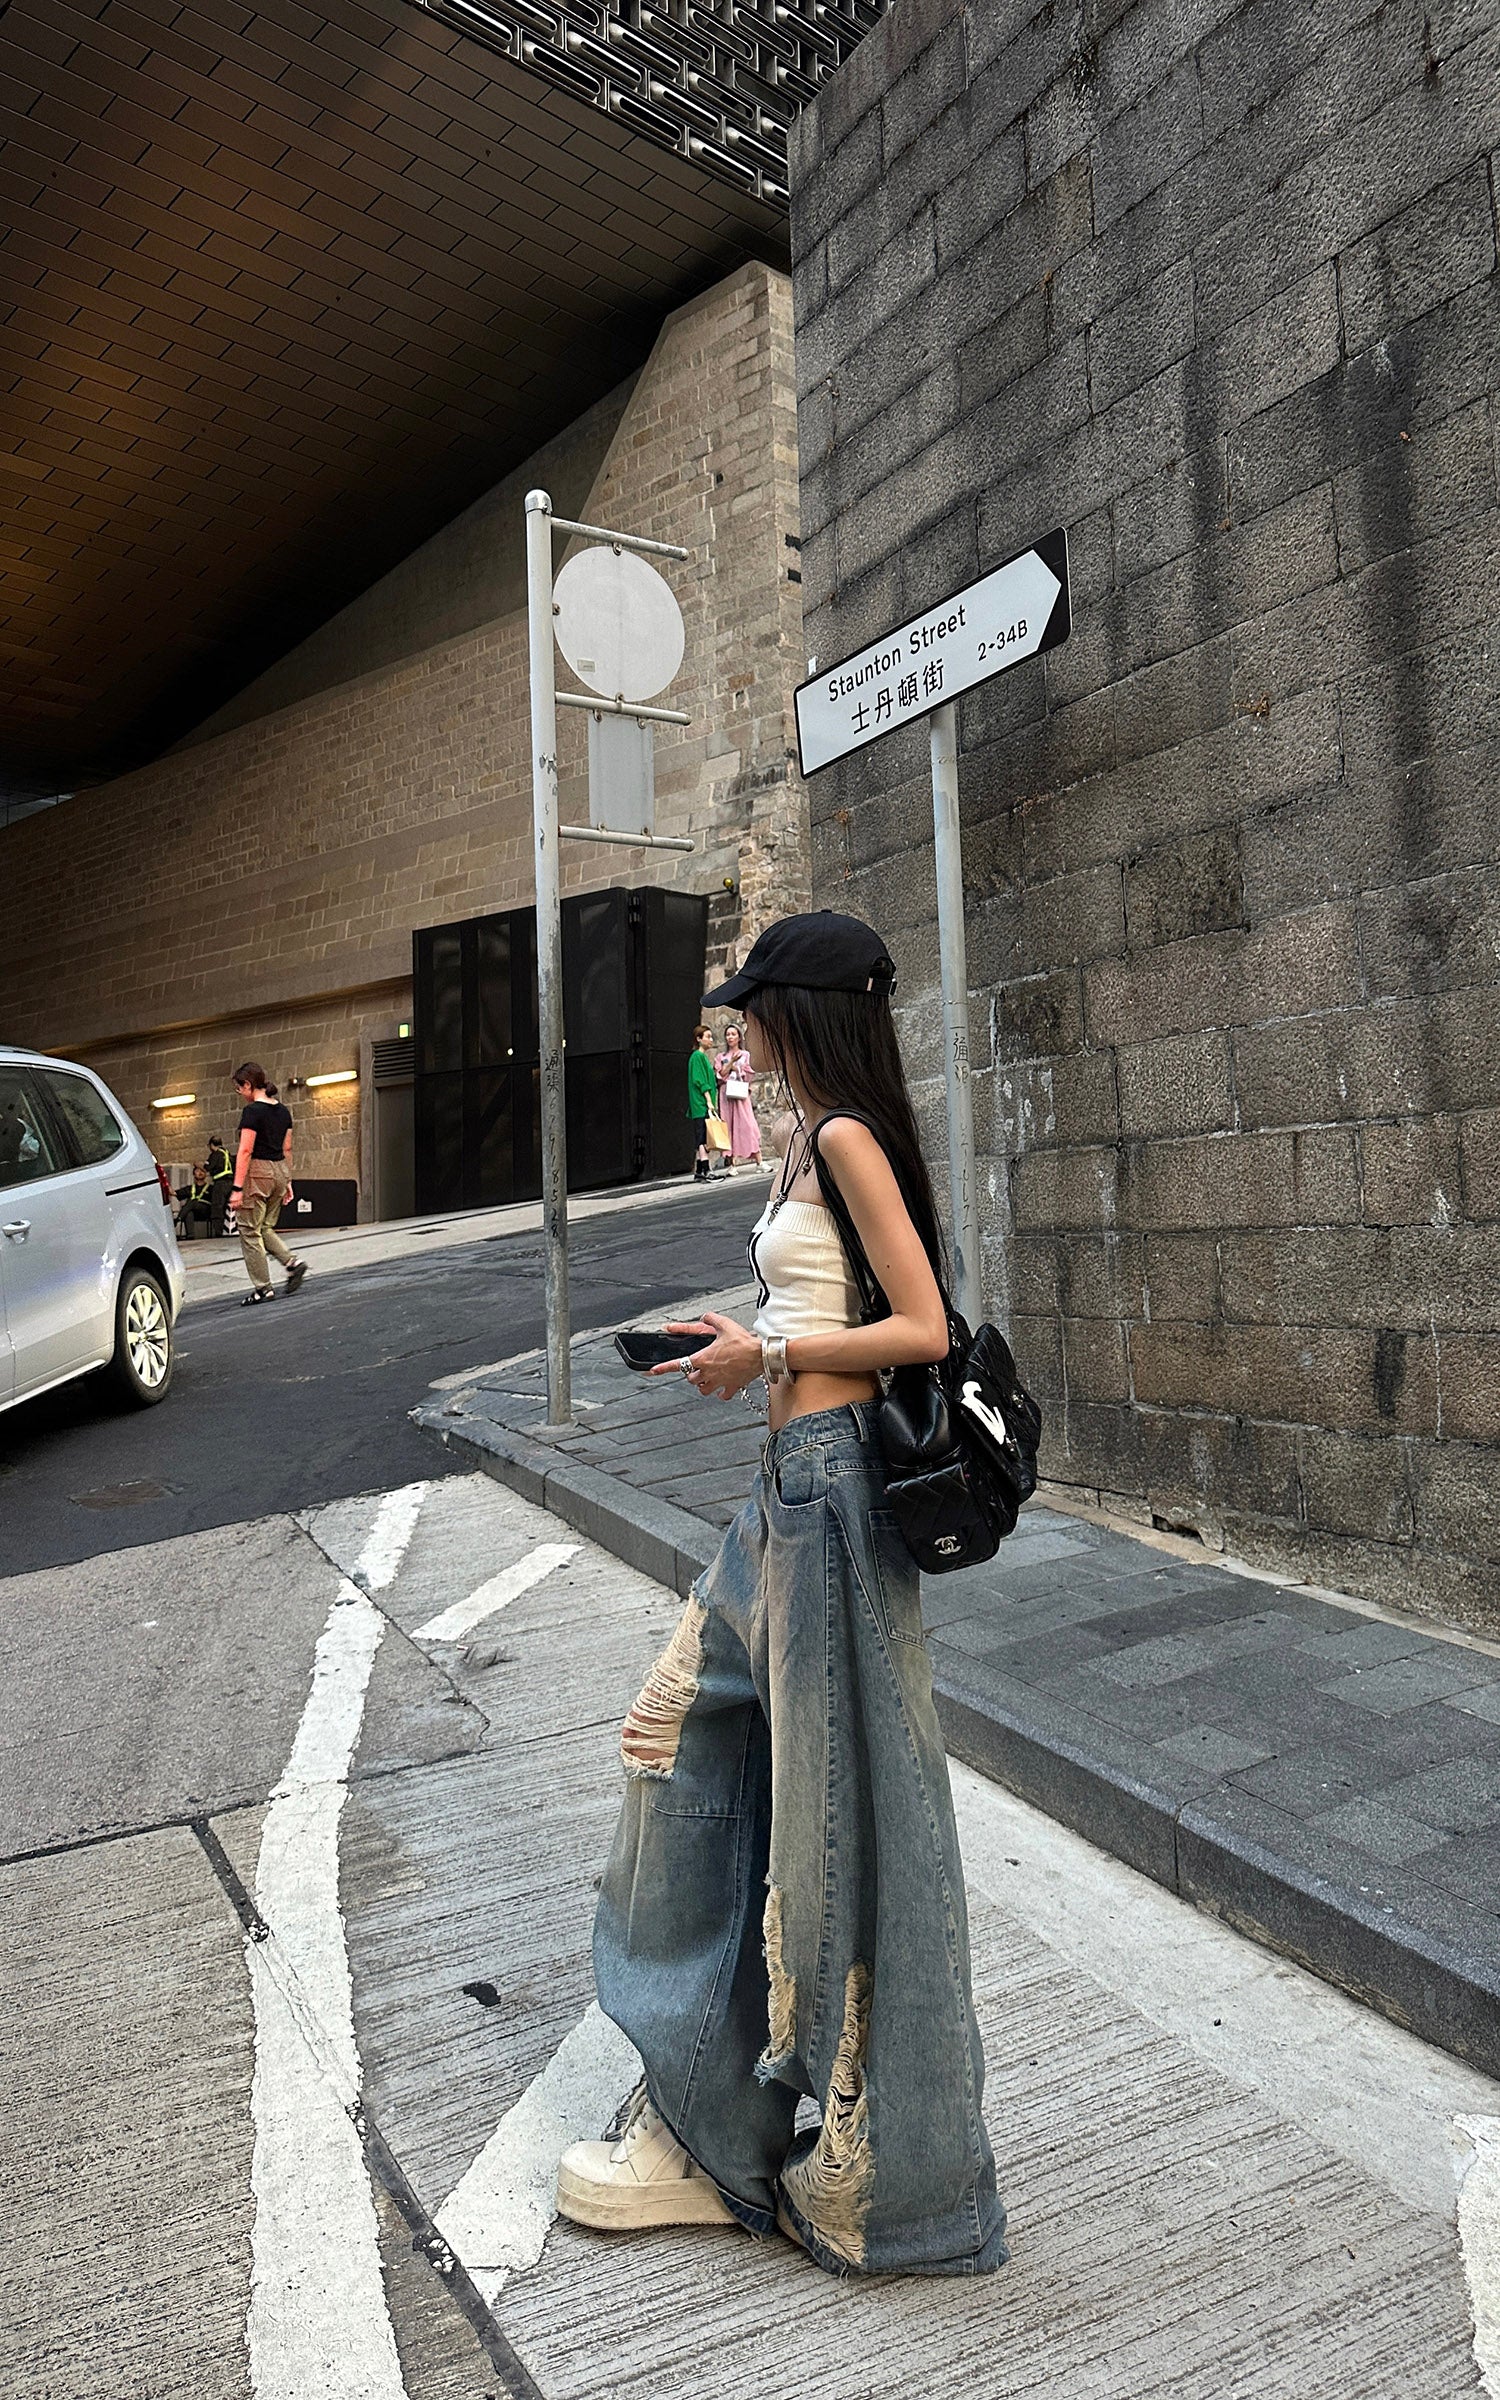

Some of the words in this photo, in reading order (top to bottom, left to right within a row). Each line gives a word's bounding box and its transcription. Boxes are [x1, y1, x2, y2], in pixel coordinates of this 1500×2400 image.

[828, 647, 902, 702] Staunton
[909, 604, 967, 655] Street
[977, 619, 1029, 662] 2-34B
[851, 657, 945, 735] 士丹頓街
